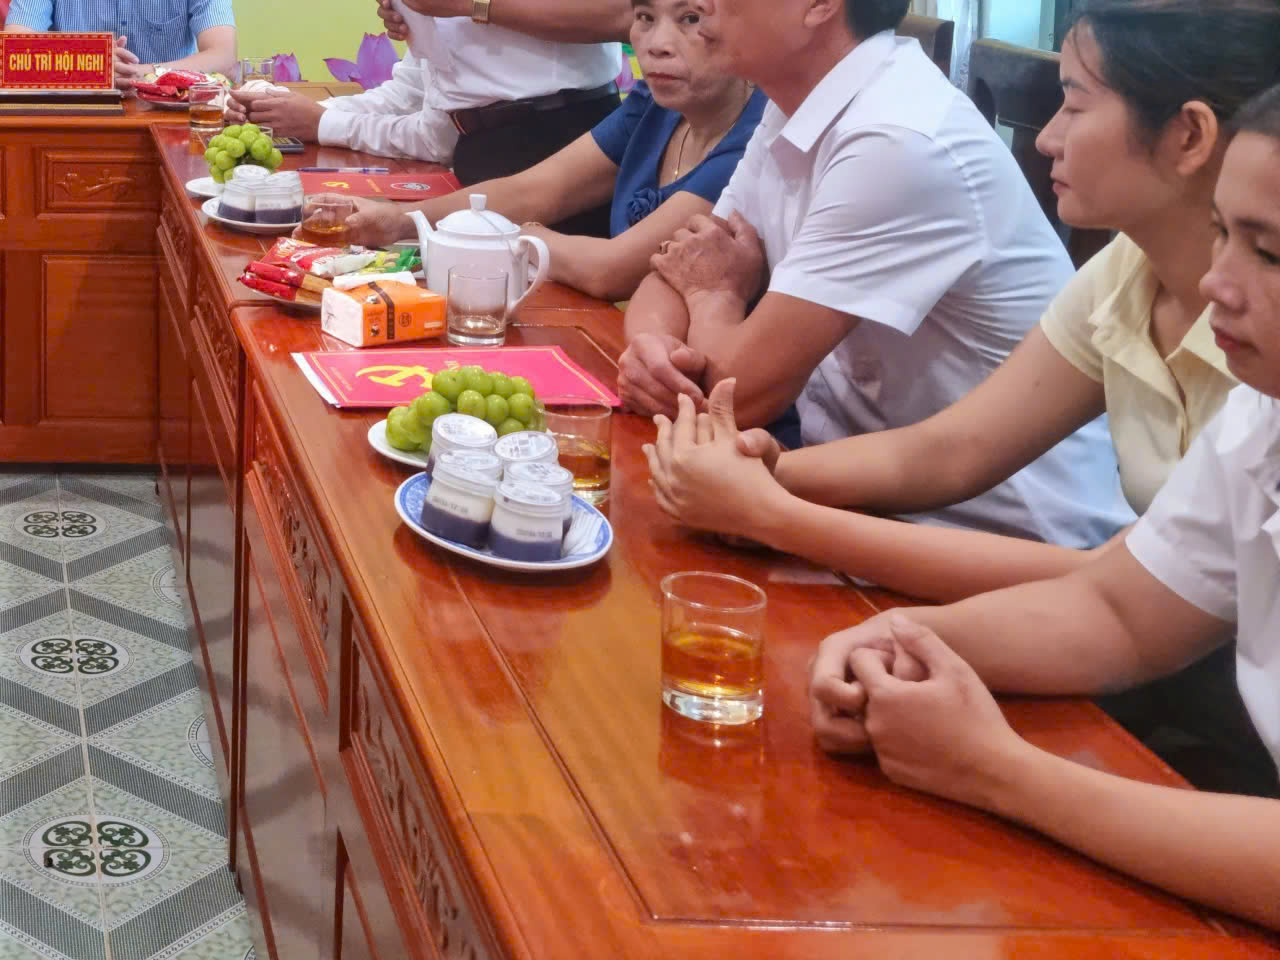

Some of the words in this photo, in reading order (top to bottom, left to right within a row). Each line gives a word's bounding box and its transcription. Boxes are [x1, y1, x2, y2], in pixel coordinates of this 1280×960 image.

[9, 48, 32, 71] CHỦ
[34, 50, 52, 71] TRÌ
[55, 50, 74, 75] HỘI
[77, 53, 104, 75] NGHỊ
